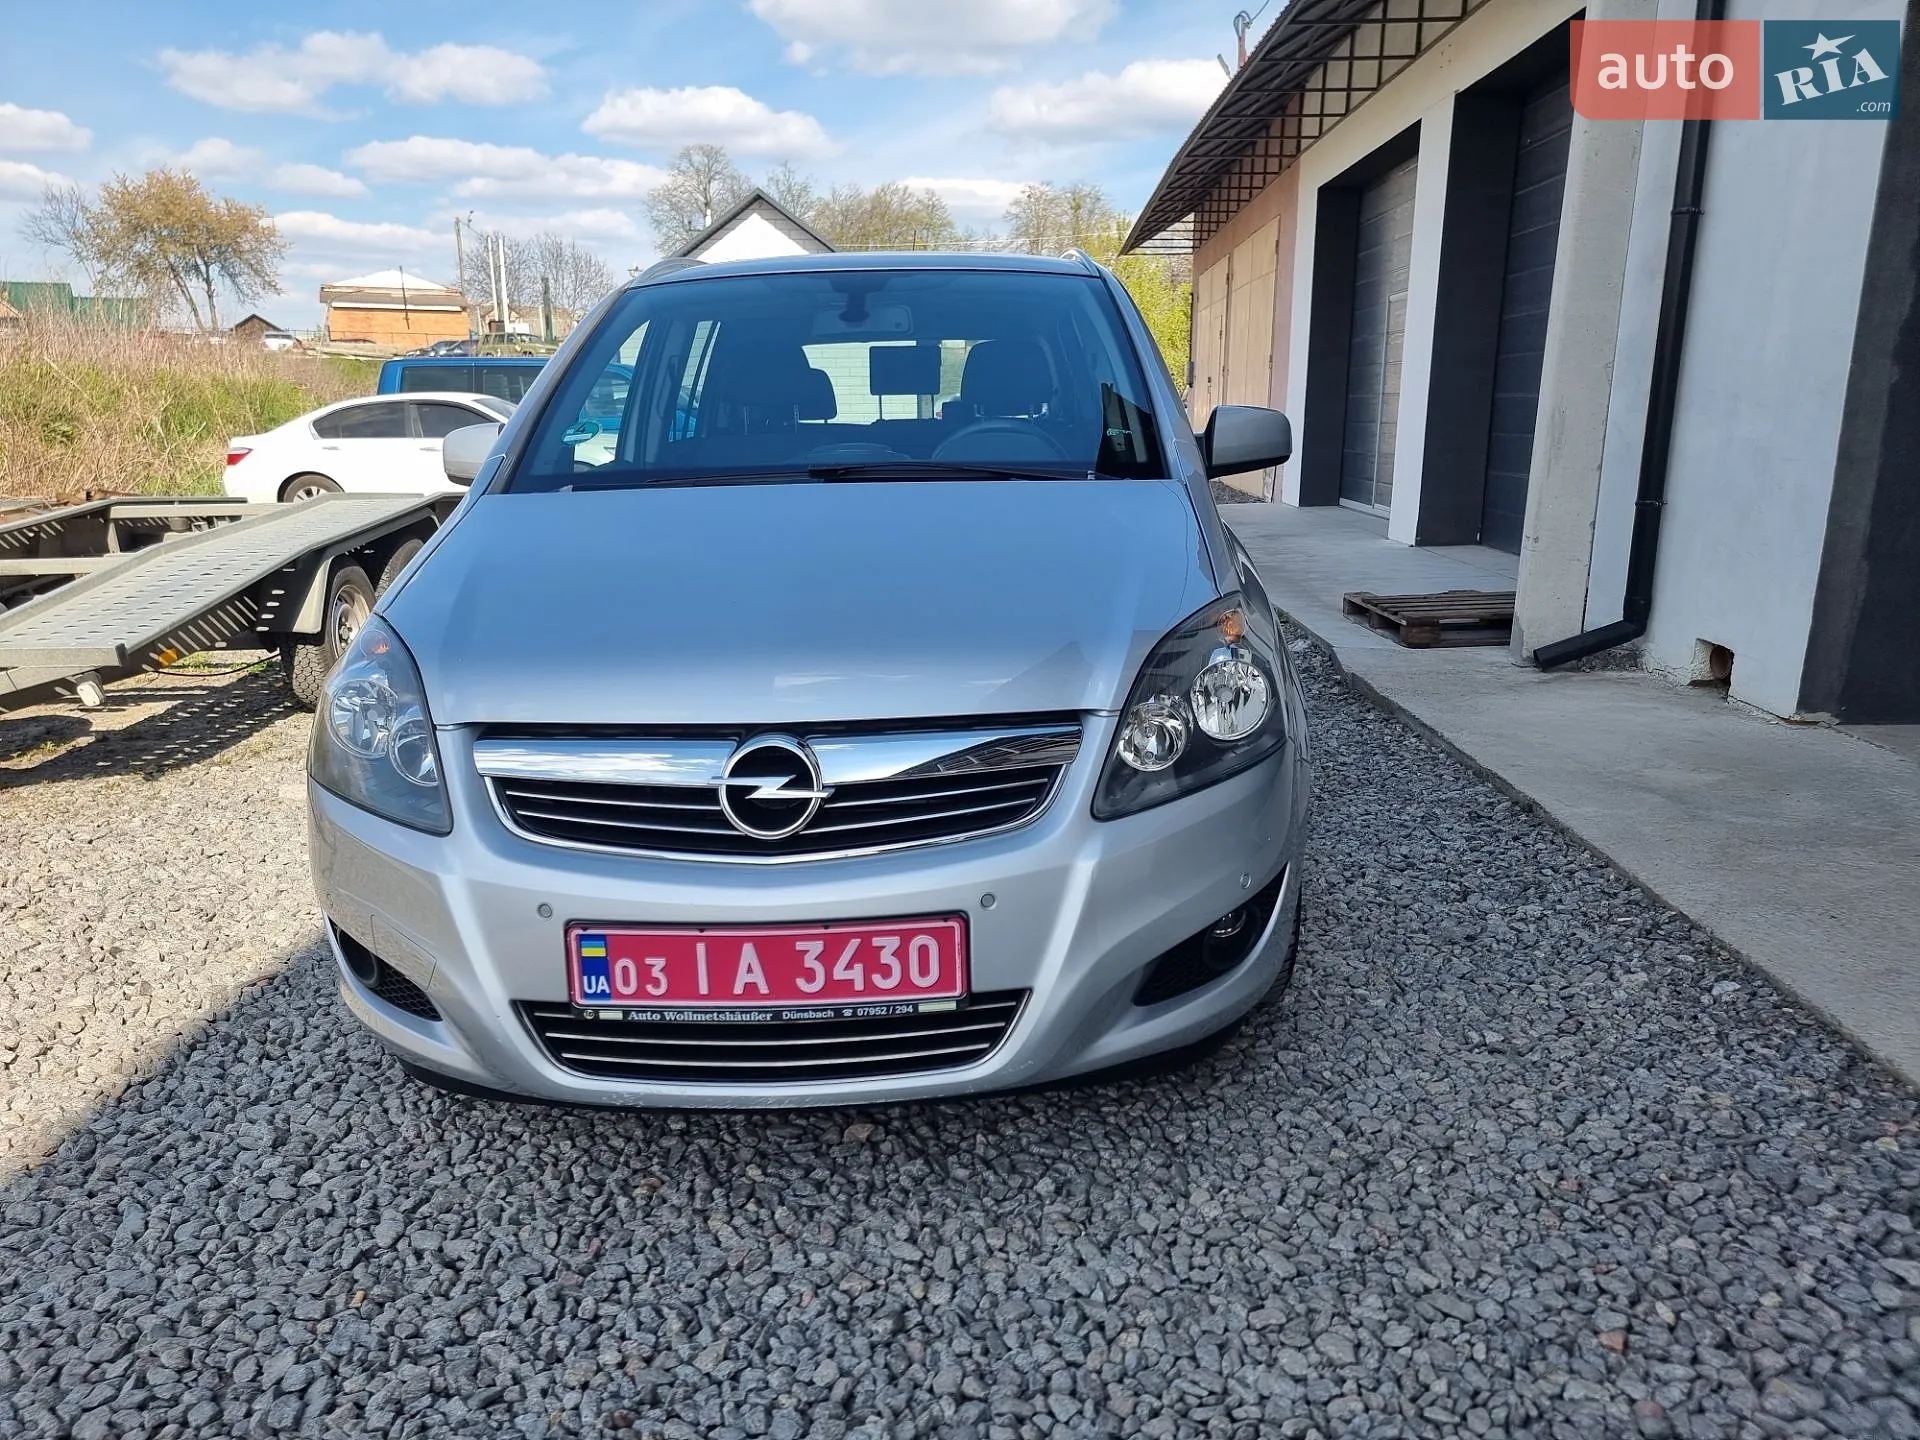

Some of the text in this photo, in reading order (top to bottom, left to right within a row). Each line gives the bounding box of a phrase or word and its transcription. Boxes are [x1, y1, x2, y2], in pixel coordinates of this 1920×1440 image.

[614, 957, 668, 996] 03
[795, 934, 940, 994] 3430
[583, 975, 611, 994] UA
[628, 1011, 661, 1022] Auto
[782, 1008, 834, 1020] Dünsbach
[857, 1007, 886, 1017] 07952
